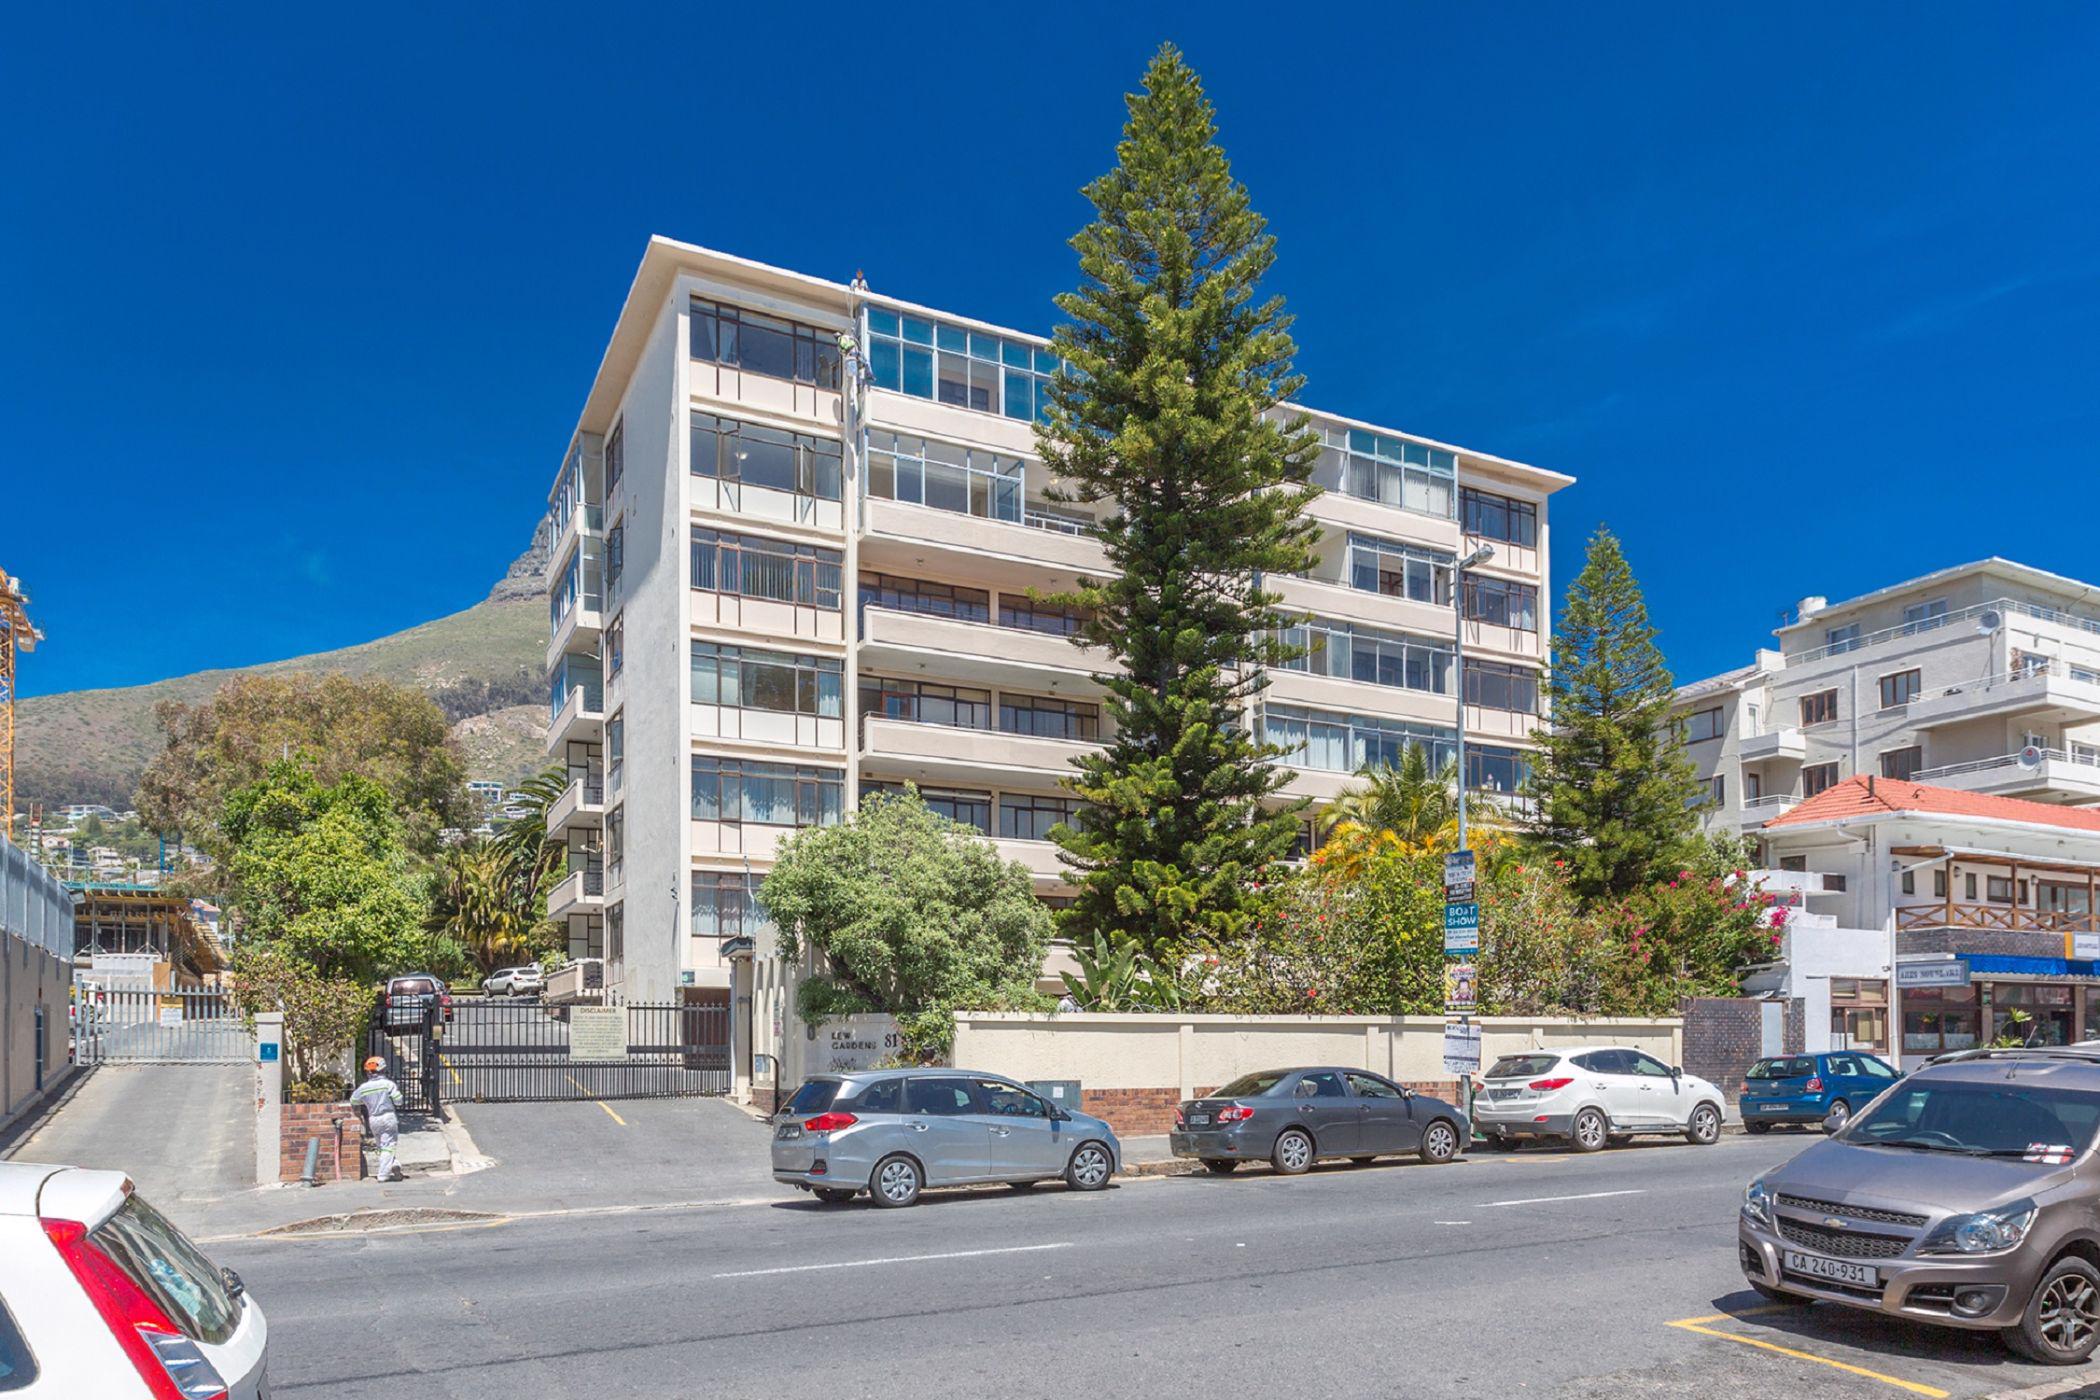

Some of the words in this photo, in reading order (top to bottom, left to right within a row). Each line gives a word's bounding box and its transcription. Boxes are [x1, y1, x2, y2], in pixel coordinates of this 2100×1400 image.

[1449, 906, 1475, 916] BOAT
[1447, 916, 1476, 926] SHOW
[831, 1041, 877, 1050] GARDENS
[884, 1033, 898, 1048] 81
[1791, 1254, 1807, 1270] CA
[1812, 1258, 1866, 1282] 240-931
